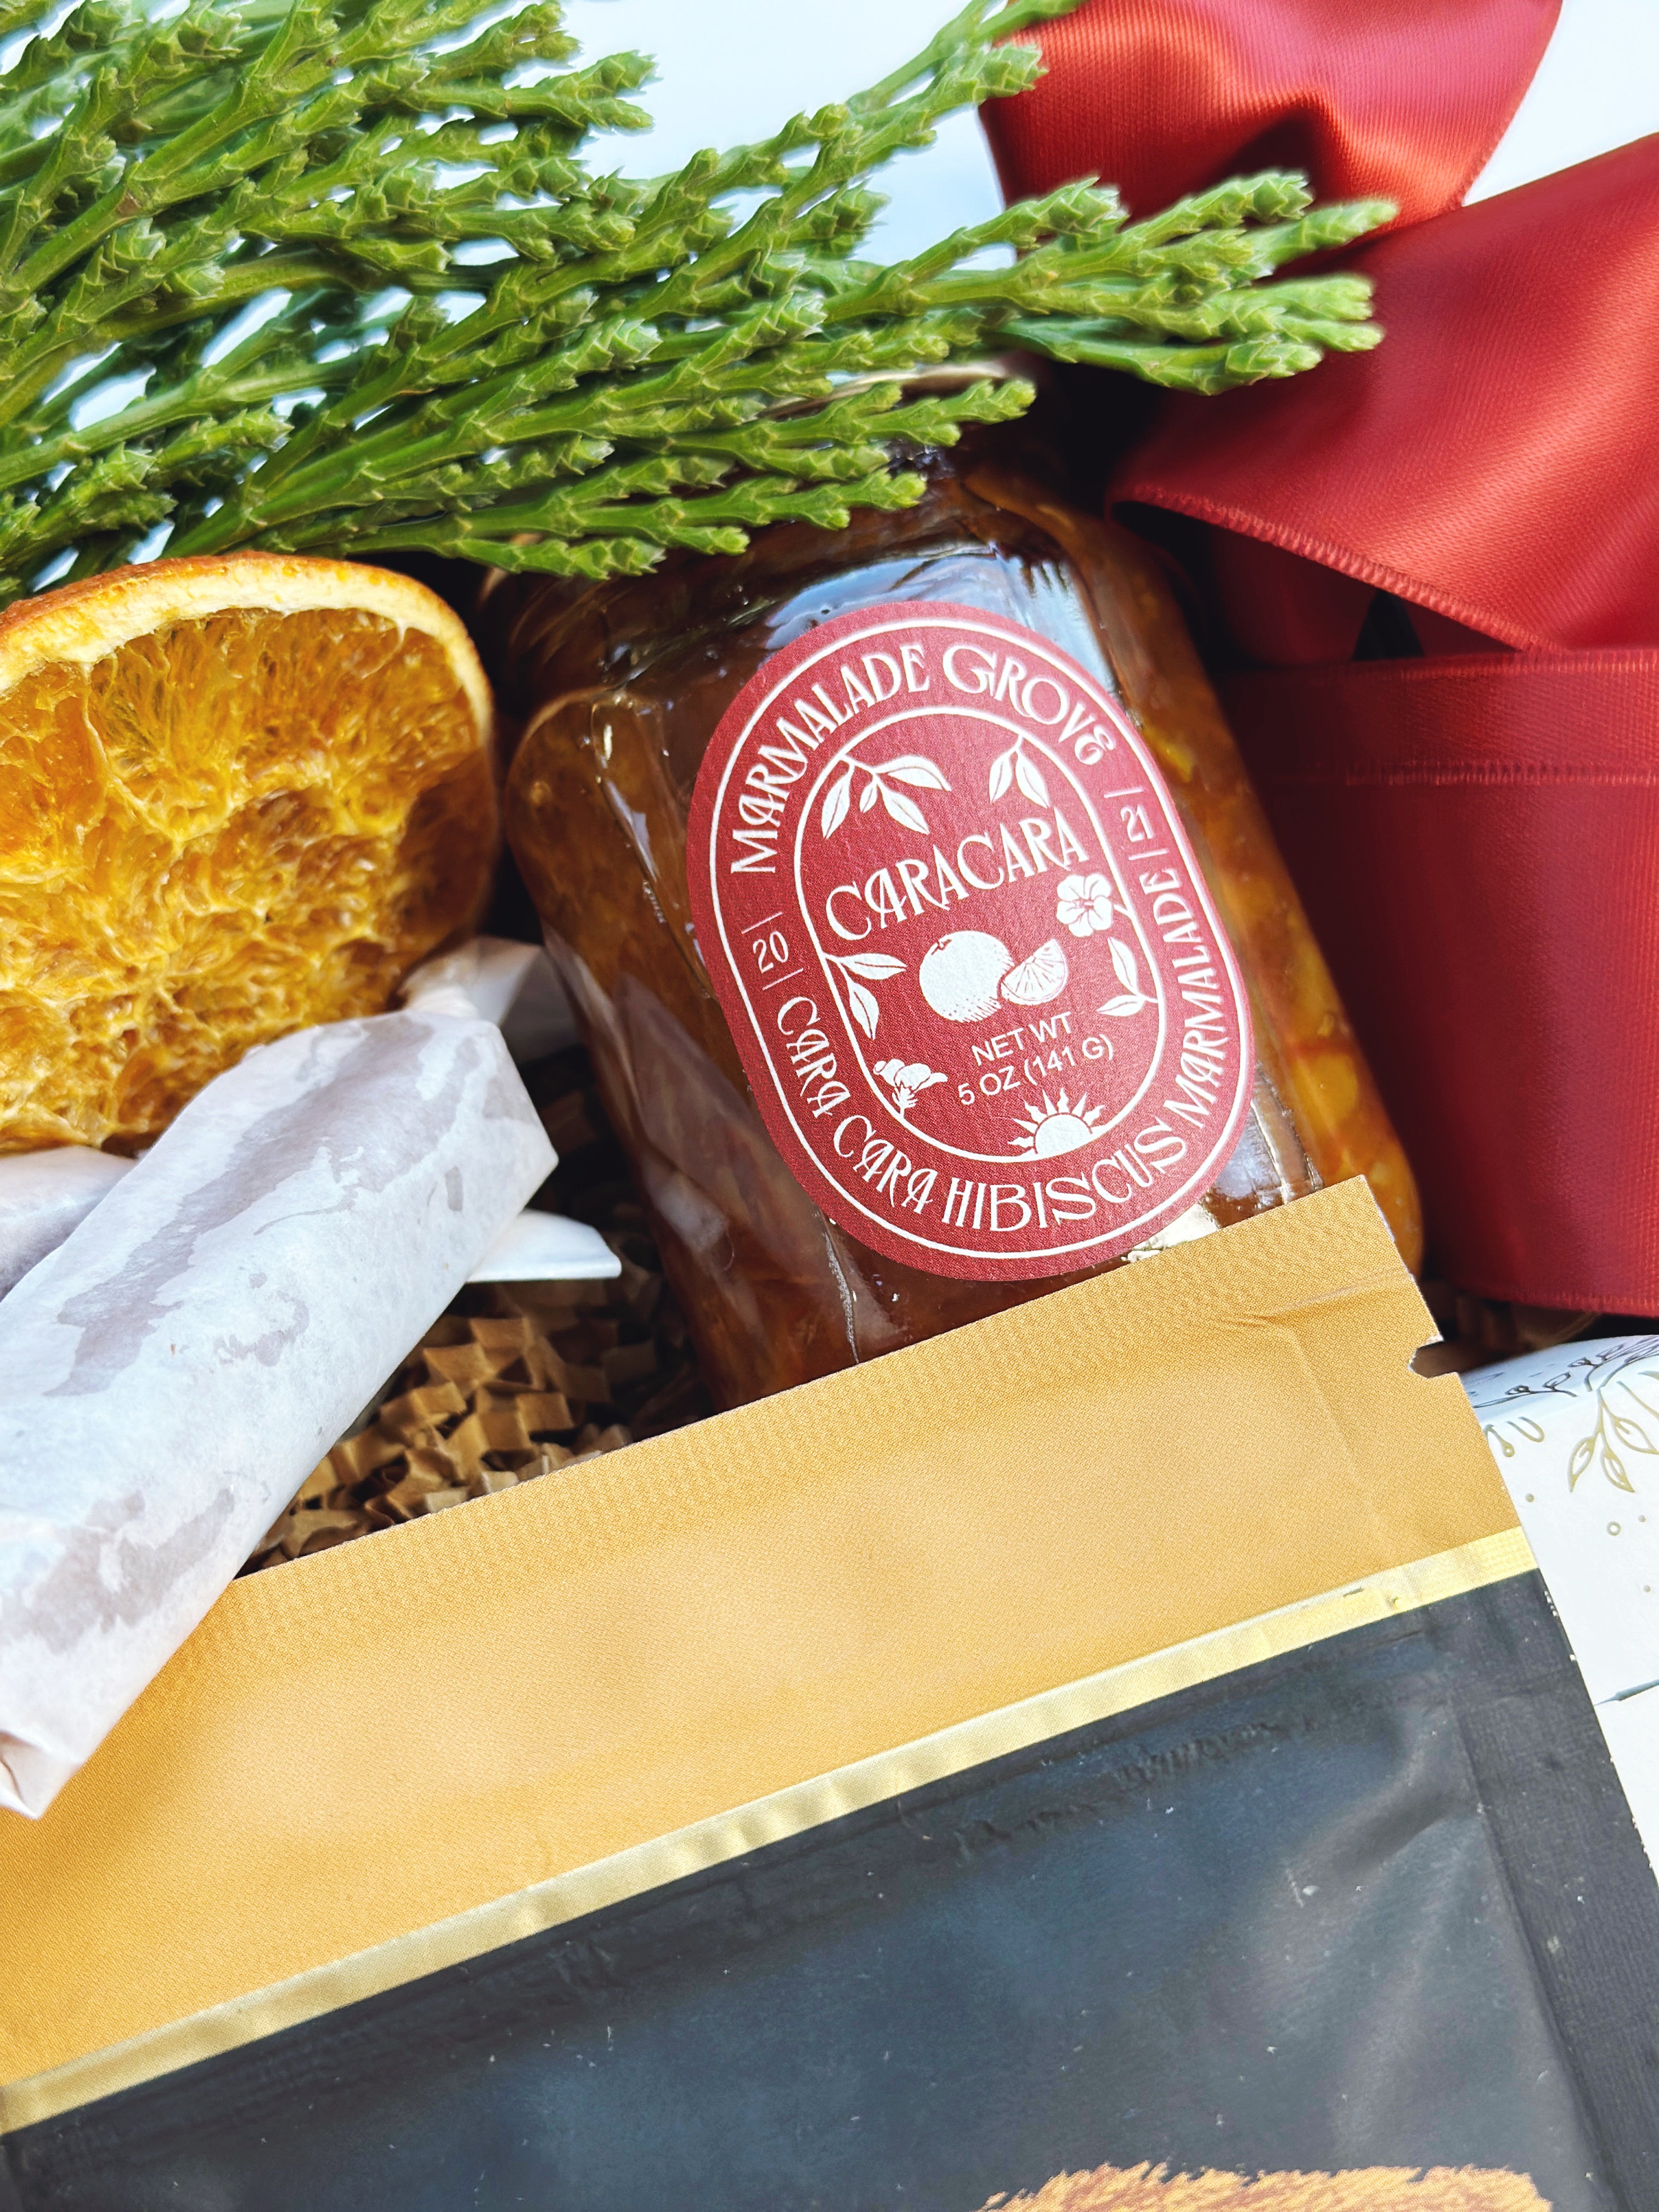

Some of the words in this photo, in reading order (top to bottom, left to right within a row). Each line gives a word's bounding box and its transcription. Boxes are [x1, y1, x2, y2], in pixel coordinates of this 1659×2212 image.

[730, 643, 930, 874] MARMALADE
[941, 644, 1117, 766] GROVE
[1120, 804, 1155, 843] 21
[825, 806, 1091, 941] CARACARA
[752, 931, 789, 974] 20
[777, 996, 851, 1119] CARA
[833, 1115, 939, 1215] CARA
[941, 1118, 1186, 1232] HIBISCUS
[1139, 867, 1230, 1128] MARMALADE
[957, 1082, 975, 1105] 5
[979, 1065, 1021, 1096] OZ
[1024, 1046, 1075, 1086] (141
[1081, 1034, 1114, 1061] G)
[971, 1027, 1024, 1067] NET
[1028, 1011, 1071, 1043] WT
